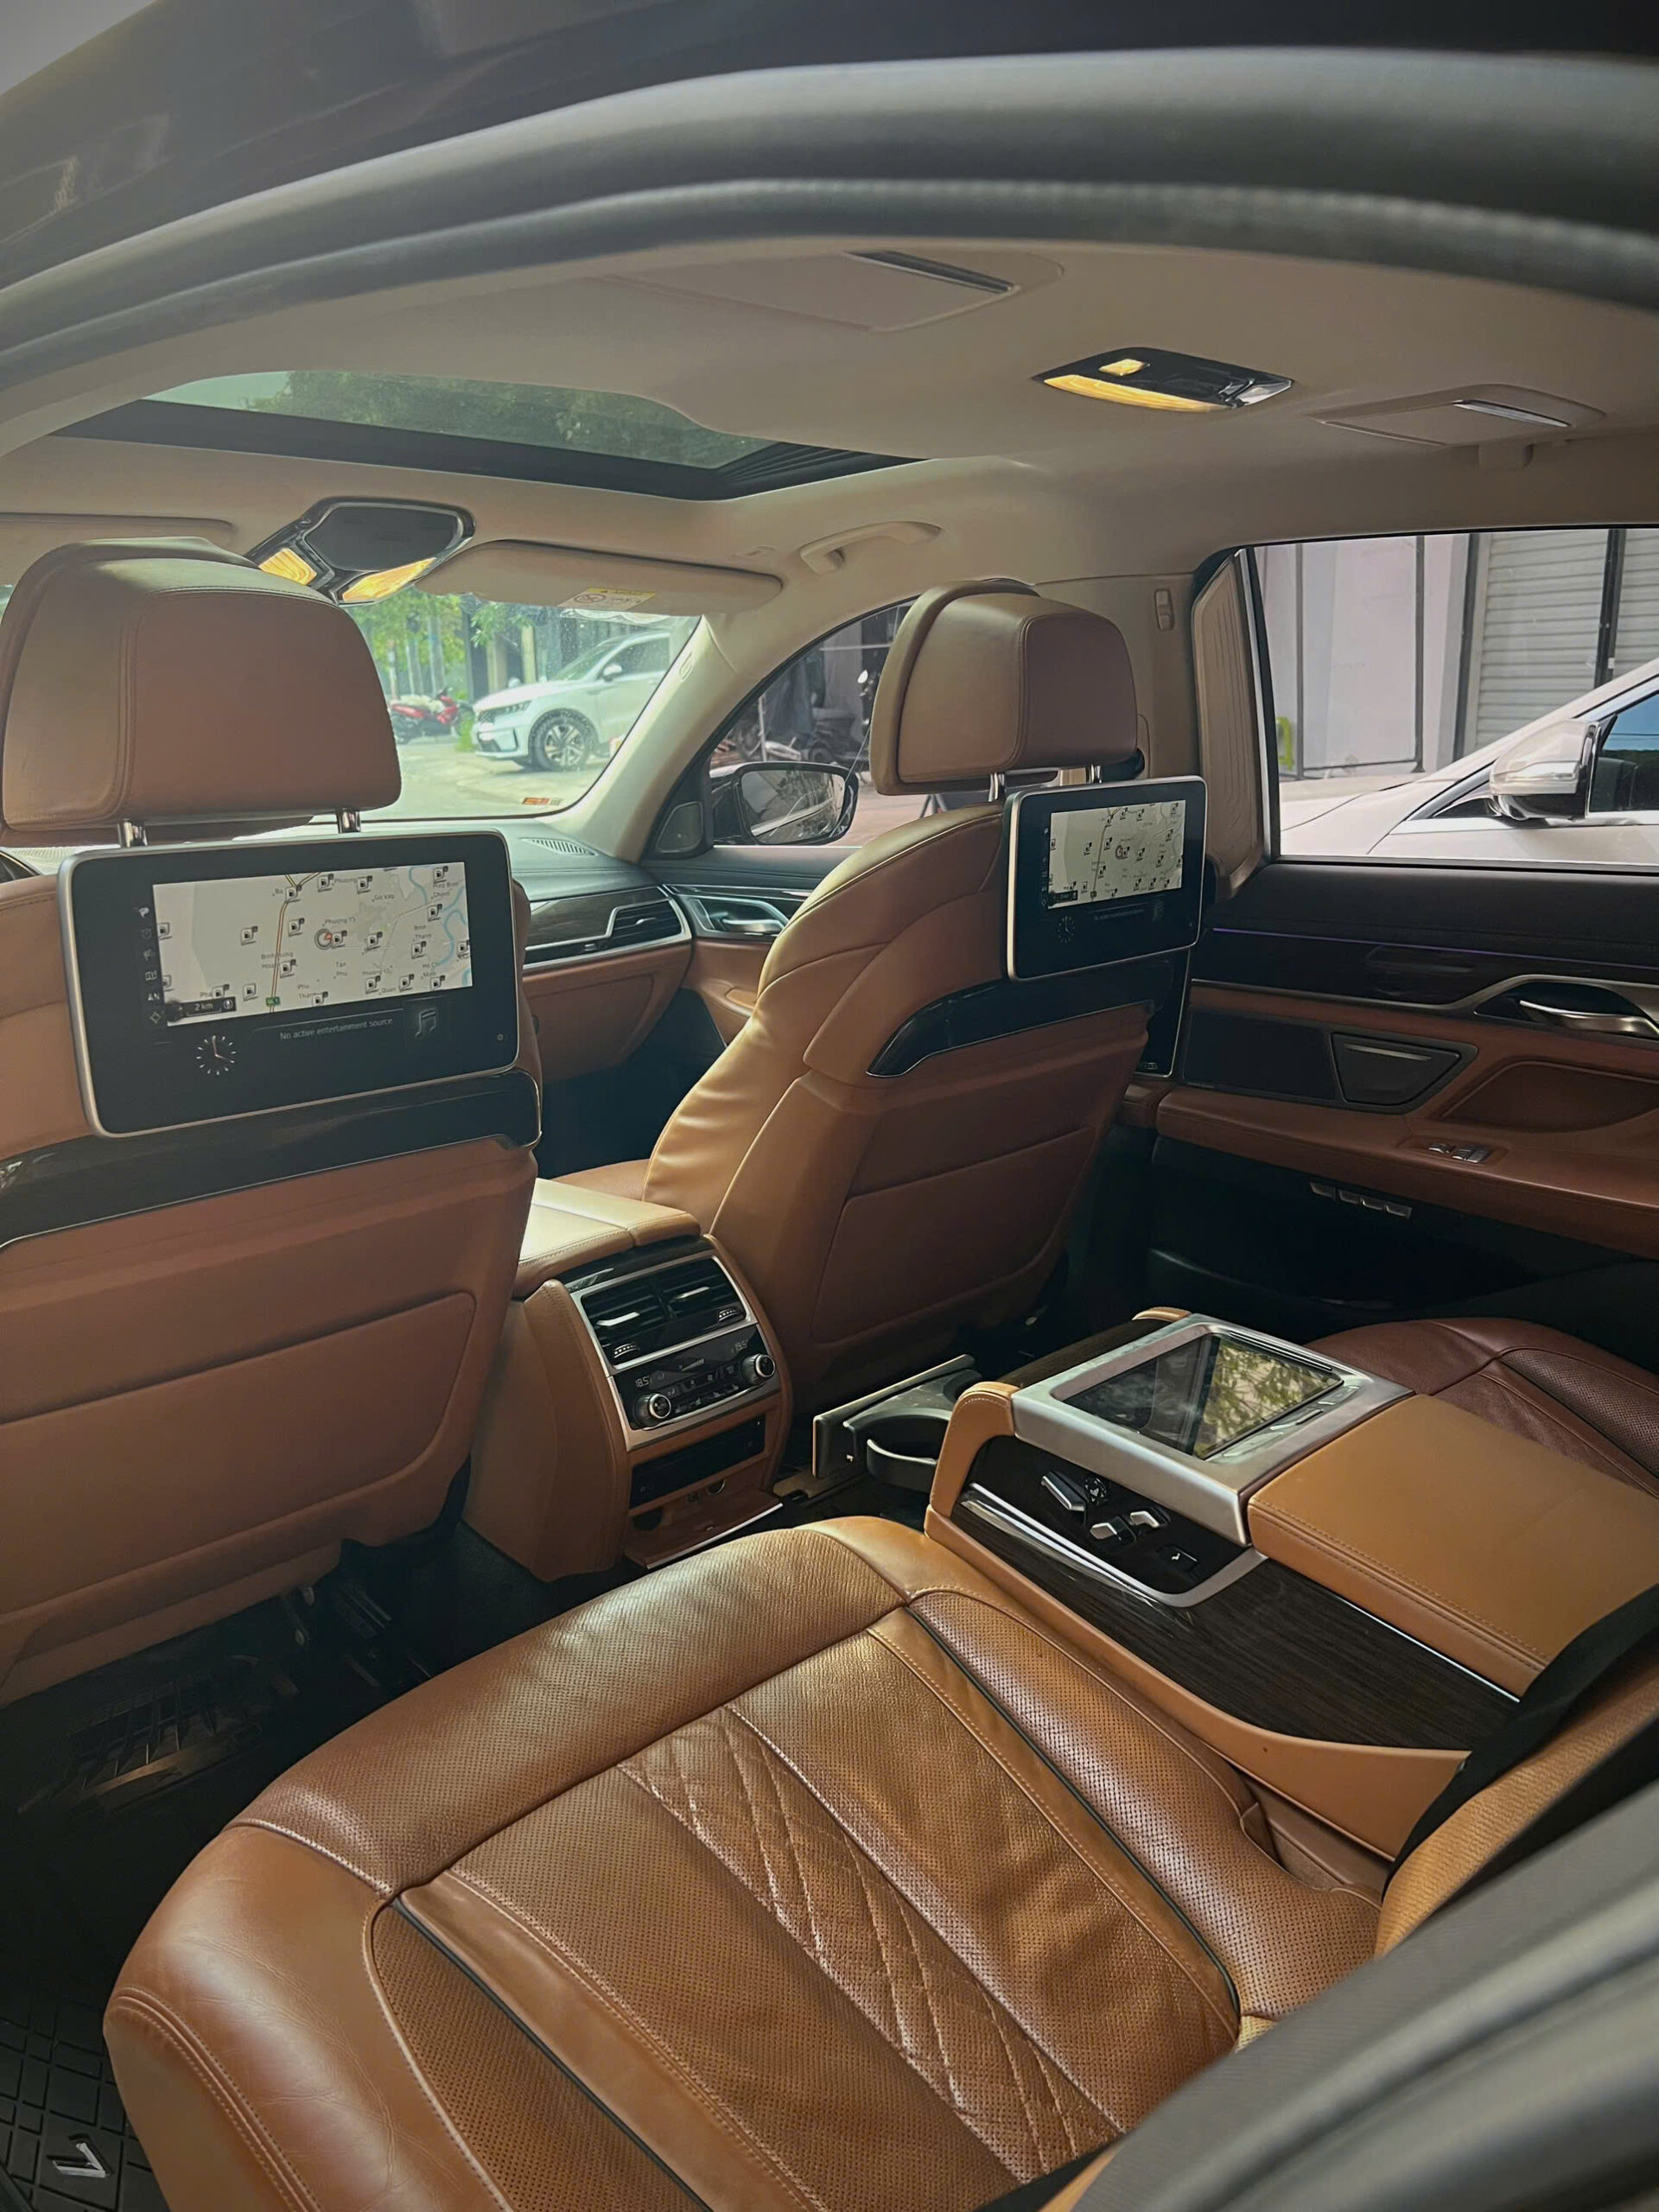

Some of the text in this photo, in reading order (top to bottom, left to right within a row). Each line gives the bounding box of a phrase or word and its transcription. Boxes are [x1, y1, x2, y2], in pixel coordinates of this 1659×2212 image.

[293, 1028, 315, 1039] active
[316, 1020, 367, 1035] entertainment
[369, 1018, 393, 1027] source
